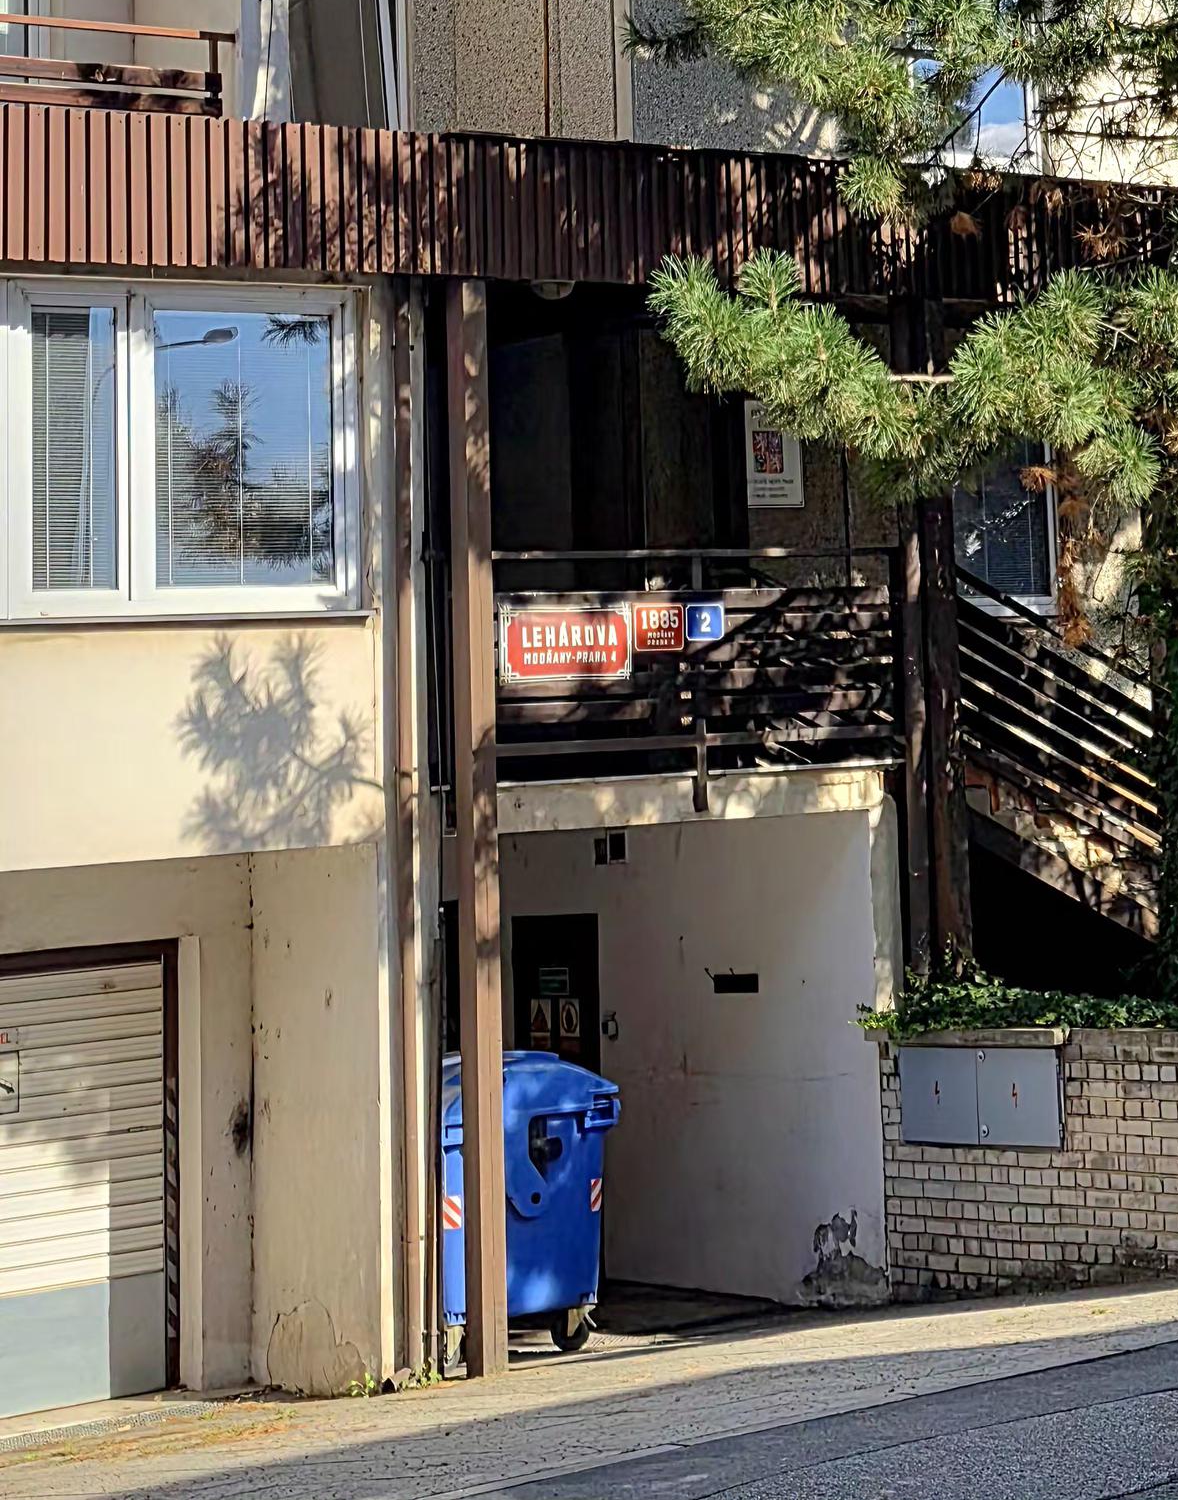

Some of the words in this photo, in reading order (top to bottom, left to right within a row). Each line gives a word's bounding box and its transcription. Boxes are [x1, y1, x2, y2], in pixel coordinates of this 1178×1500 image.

[641, 609, 679, 630] 1885
[700, 611, 711, 633] 2
[521, 621, 618, 648] LEHÁROVA
[610, 650, 617, 663] 4
